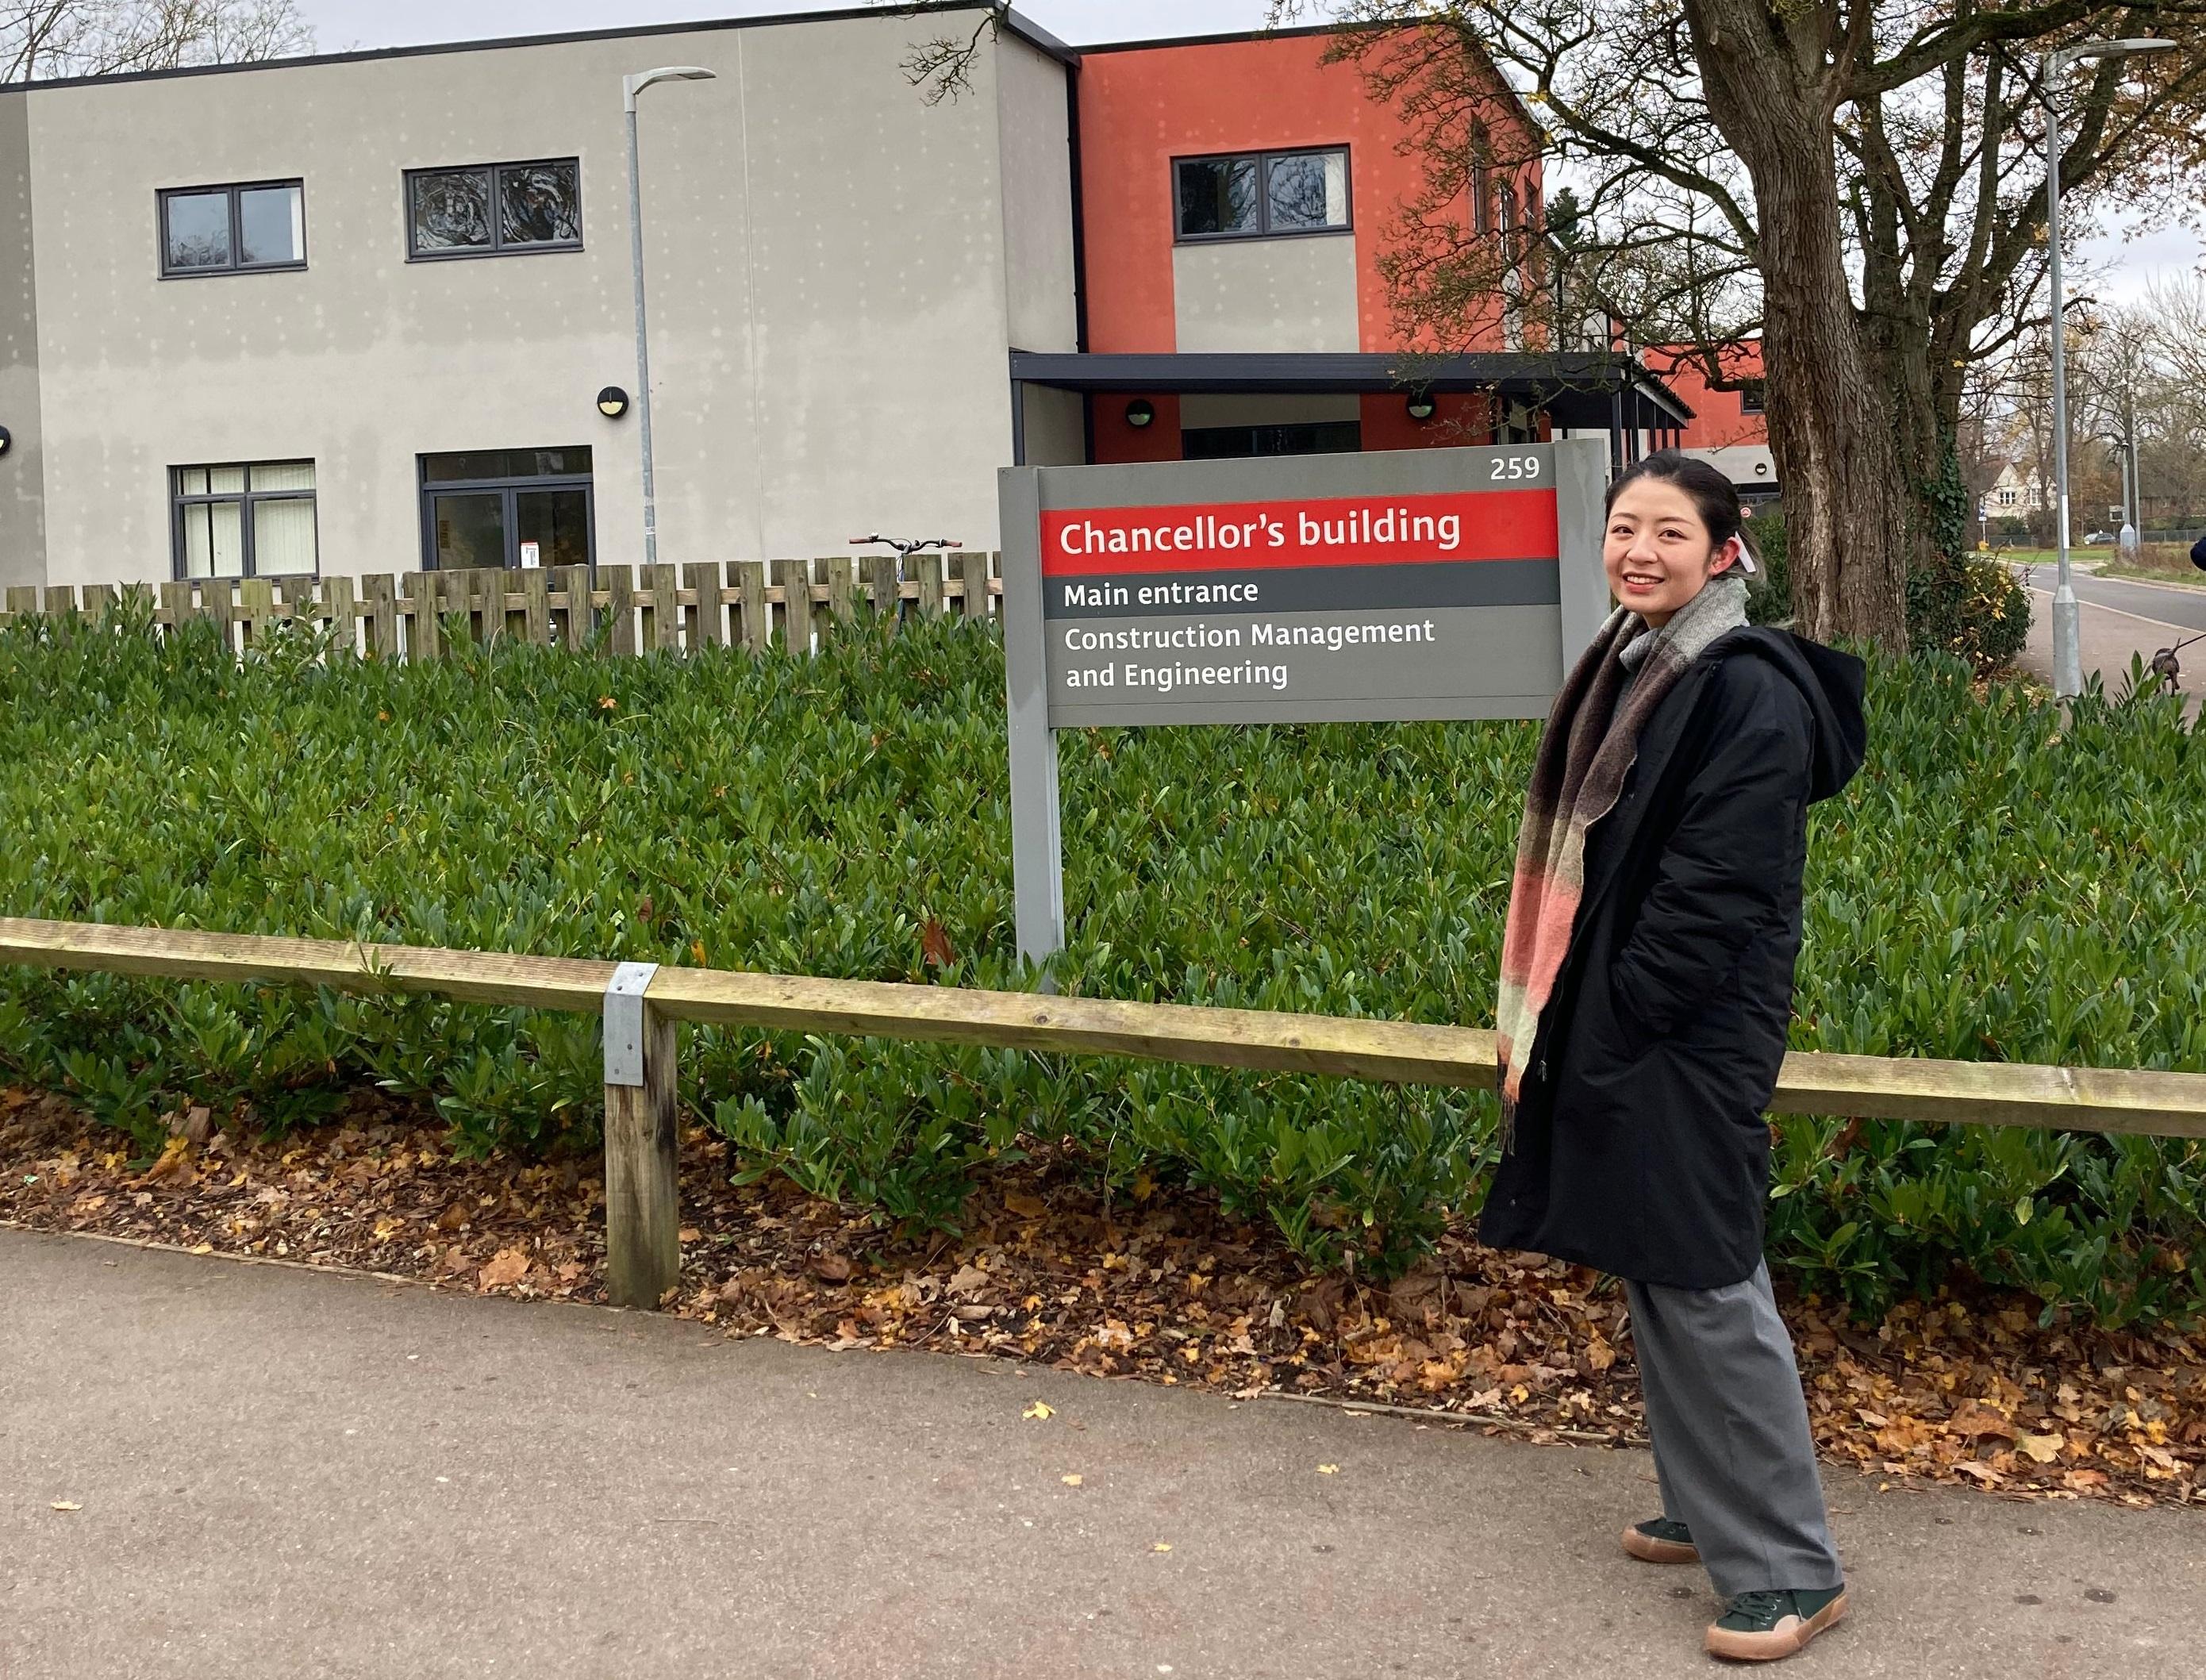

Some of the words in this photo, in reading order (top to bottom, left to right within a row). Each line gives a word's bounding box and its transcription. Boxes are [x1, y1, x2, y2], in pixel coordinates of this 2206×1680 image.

[1490, 456, 1540, 480] 259
[1059, 510, 1286, 555] Chancellor’s
[1298, 506, 1462, 550] building
[1064, 582, 1129, 607] Main
[1137, 582, 1259, 606] entrance
[1064, 623, 1241, 651] Construction
[1251, 619, 1436, 652] Management
[1066, 661, 1116, 688] and
[1124, 659, 1289, 693] Engineering
